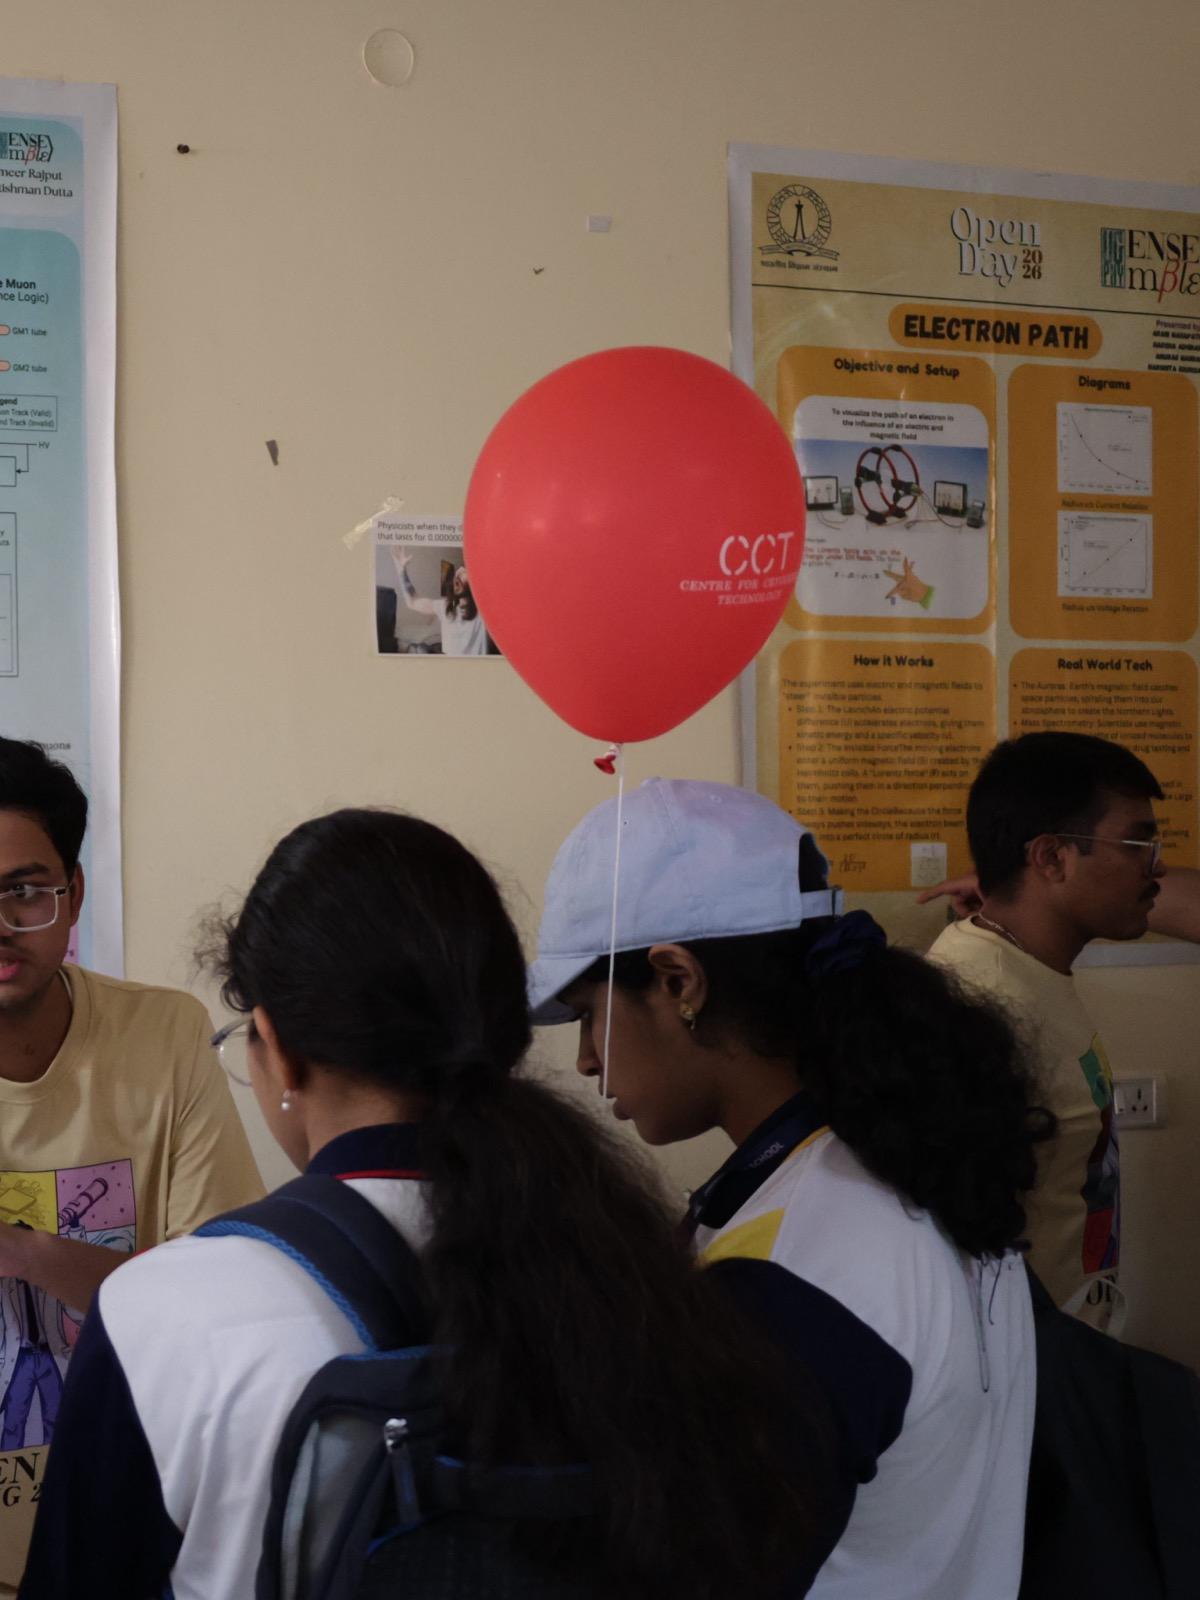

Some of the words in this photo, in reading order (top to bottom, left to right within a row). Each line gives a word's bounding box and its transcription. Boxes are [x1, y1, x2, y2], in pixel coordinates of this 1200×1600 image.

[28, 168, 62, 182] Rajput
[43, 186, 72, 197] Dutta
[950, 207, 1041, 248] Open
[1022, 248, 1043, 264] 20
[958, 242, 1019, 288] Day
[1022, 264, 1042, 280] 26
[5, 278, 36, 289] Muon
[18, 292, 48, 304] Logic)
[904, 315, 1020, 343] ELECTRON
[1028, 324, 1088, 348] PATH
[833, 358, 893, 373] Objective
[896, 363, 919, 374] and
[925, 364, 960, 379] Setup
[1078, 376, 1130, 390] Diagrams
[377, 521, 414, 530] Physicists
[416, 522, 438, 530] when
[439, 523, 458, 533] they
[719, 531, 795, 576] CCT
[679, 580, 732, 591] CENTRE
[738, 579, 758, 590] FOR
[853, 654, 880, 666] How
[882, 654, 891, 666] it
[894, 655, 934, 667] Works
[1057, 658, 1083, 670] Real
[1086, 658, 1121, 670] World
[1124, 659, 1152, 671] Tech
